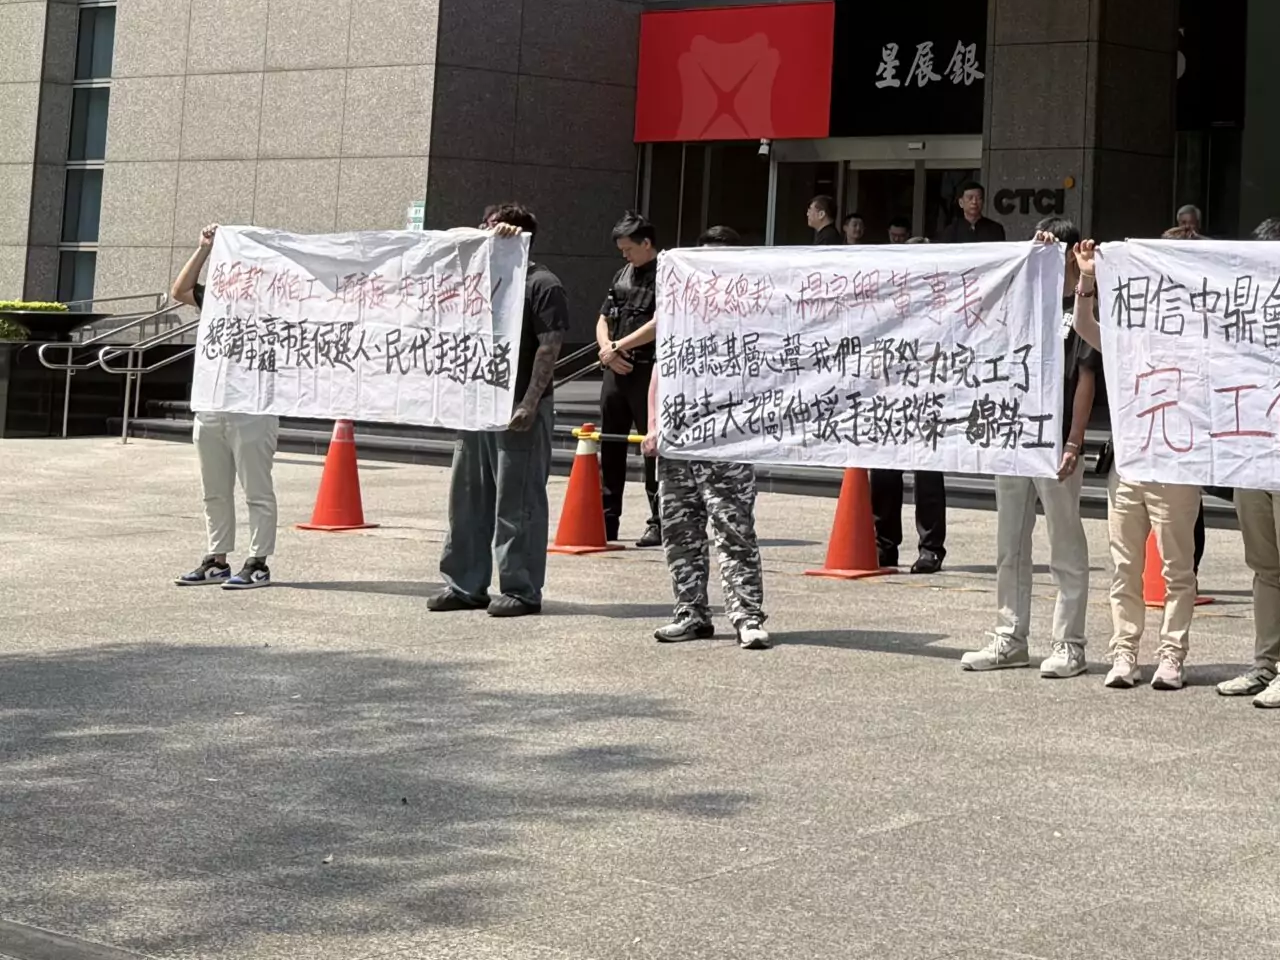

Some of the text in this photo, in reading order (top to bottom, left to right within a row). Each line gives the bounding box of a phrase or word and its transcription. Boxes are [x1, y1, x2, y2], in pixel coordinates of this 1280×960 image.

[875, 40, 985, 89] 星展銀
[993, 188, 1065, 216] CTCI
